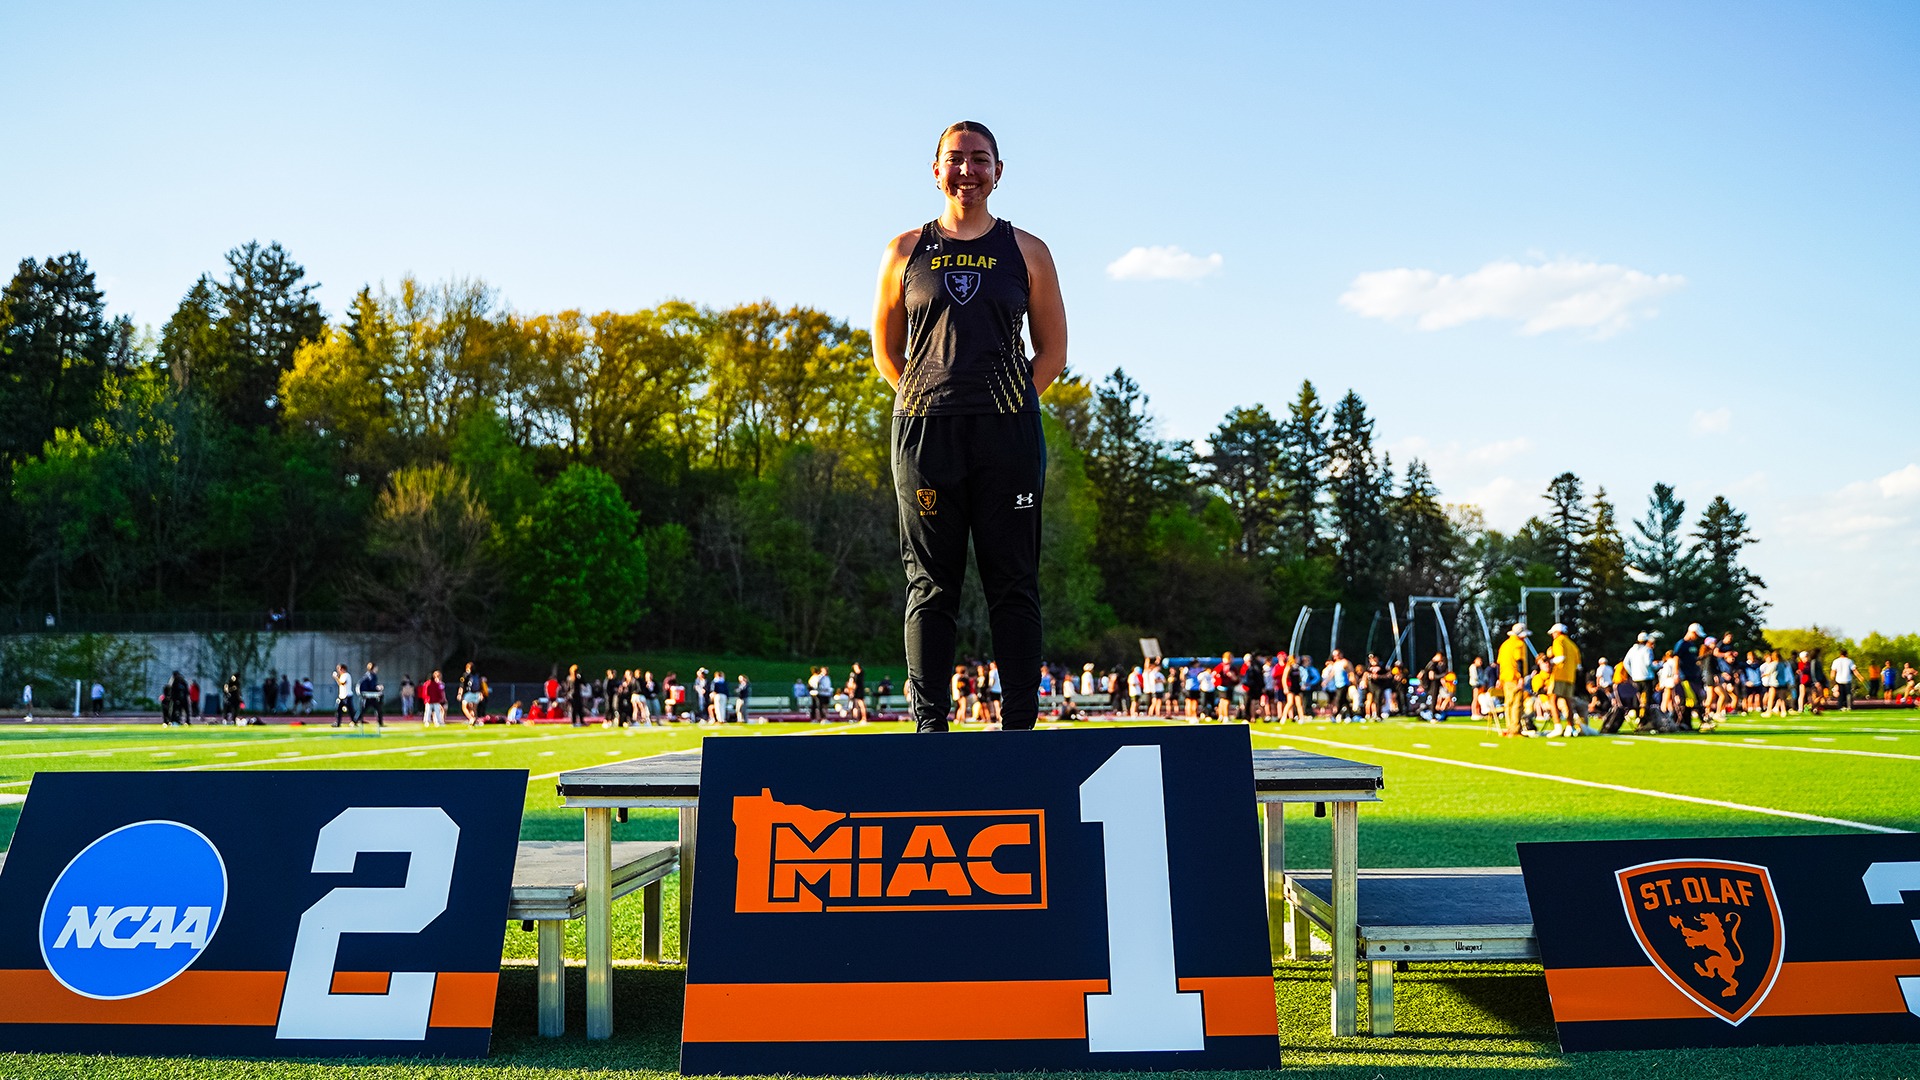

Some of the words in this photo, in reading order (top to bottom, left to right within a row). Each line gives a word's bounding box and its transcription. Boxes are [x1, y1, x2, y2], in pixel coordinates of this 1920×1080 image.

[931, 254, 953, 270] ST.
[956, 254, 997, 269] OLAF
[773, 823, 1032, 897] MIAC
[1079, 745, 1205, 1052] 1
[1640, 879, 1681, 910] ST.
[1682, 877, 1754, 907] OLAF
[52, 906, 212, 949] NCAA
[275, 807, 460, 1041] 2
